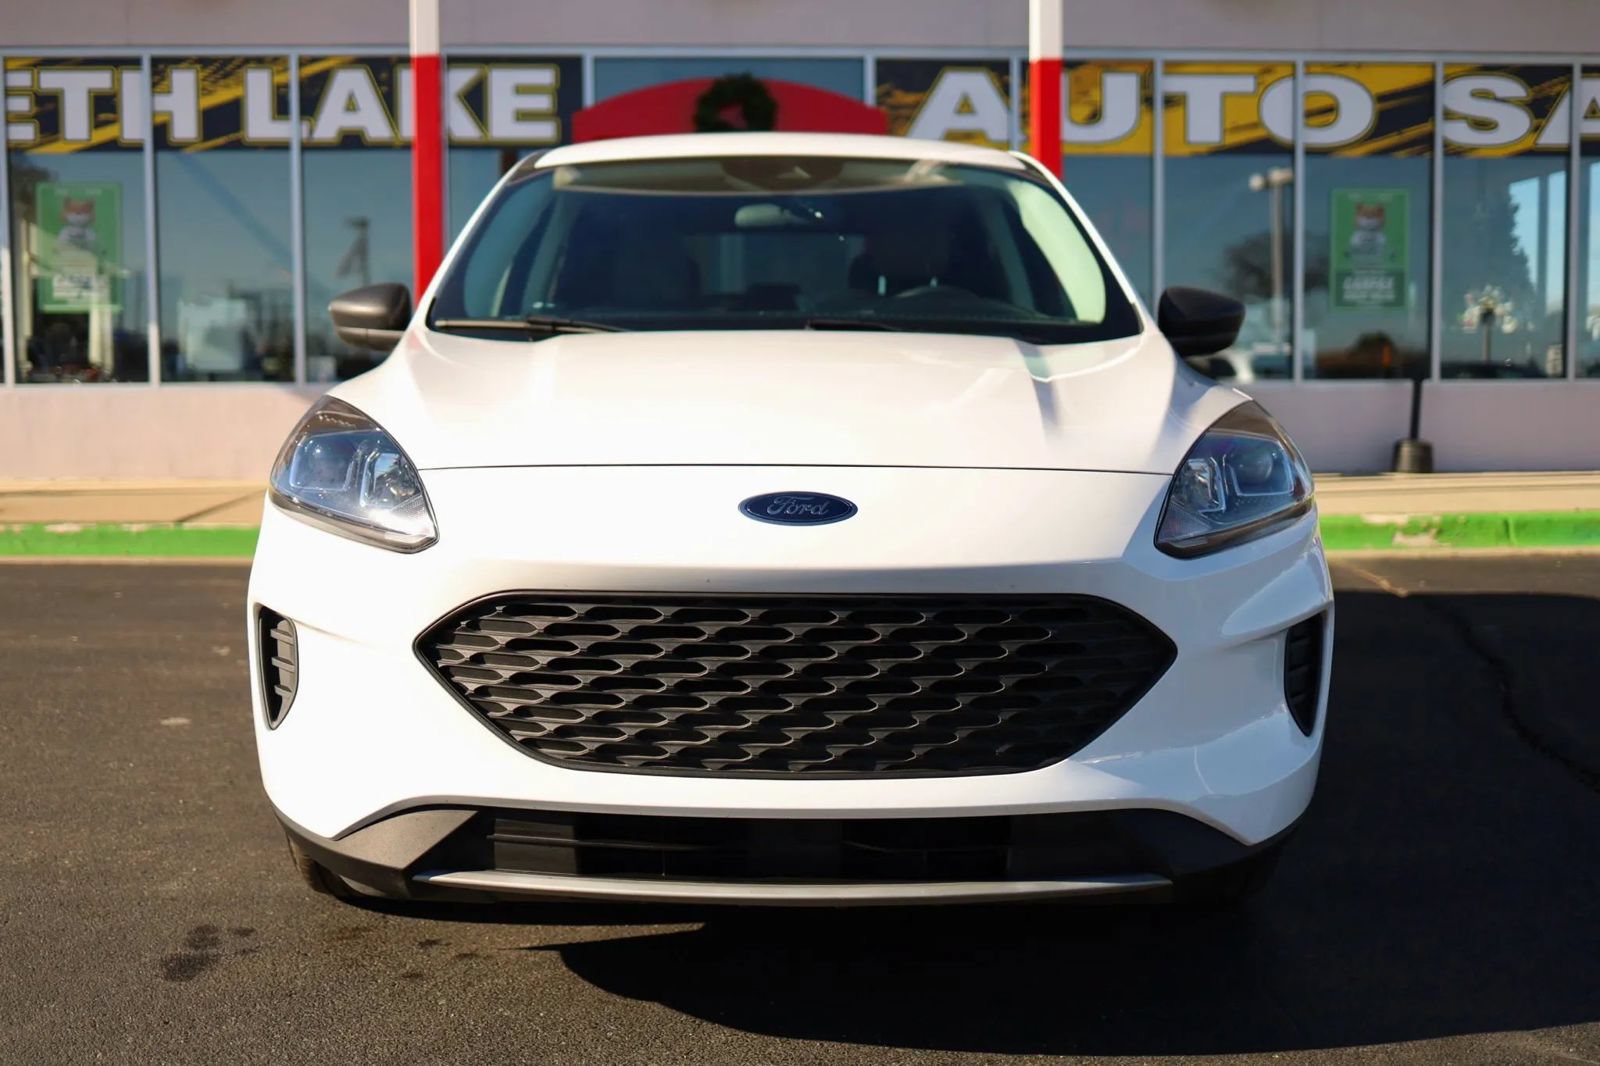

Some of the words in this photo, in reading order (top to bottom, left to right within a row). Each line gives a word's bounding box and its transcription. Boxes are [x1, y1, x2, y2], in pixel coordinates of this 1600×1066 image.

[243, 67, 559, 143] LAKE
[906, 70, 1375, 146] AUTO
[767, 495, 831, 515] Ford
